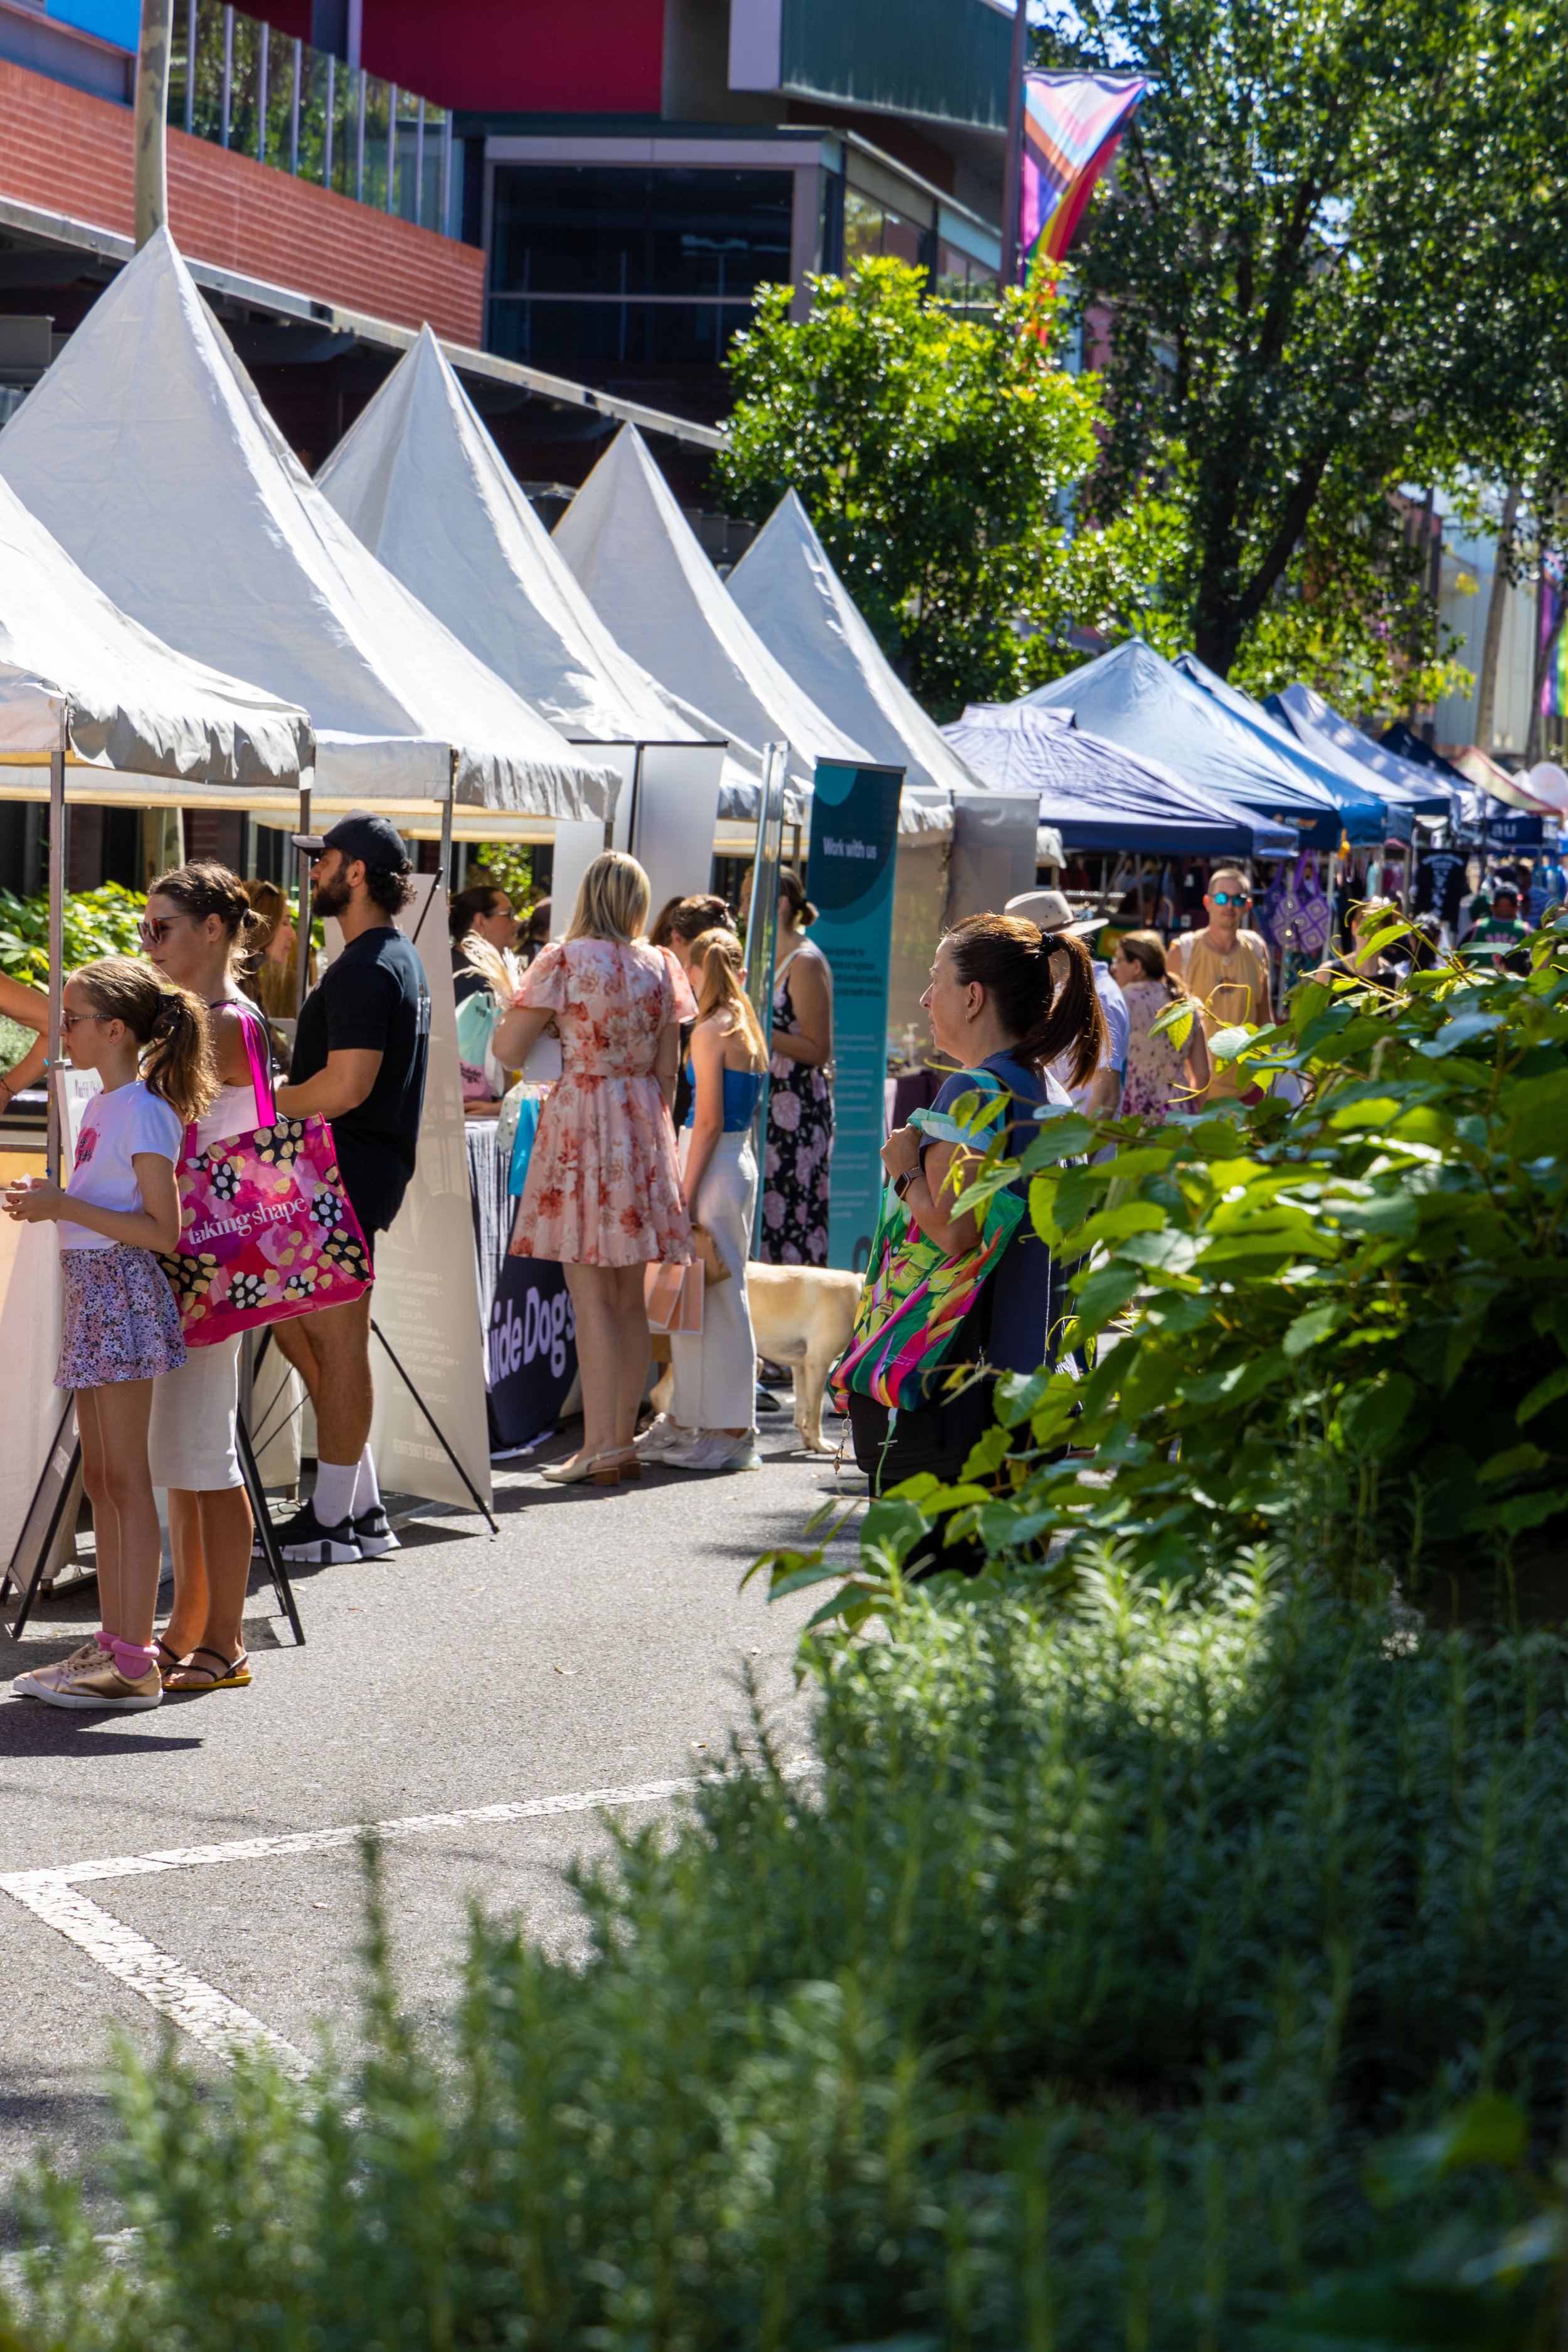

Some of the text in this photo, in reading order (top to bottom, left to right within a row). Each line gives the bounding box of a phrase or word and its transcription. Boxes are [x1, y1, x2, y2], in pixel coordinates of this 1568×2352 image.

[822, 836, 877, 861] Work with us
[188, 1197, 307, 1245] taking shape
[486, 1286, 576, 1394] uide Dogs
